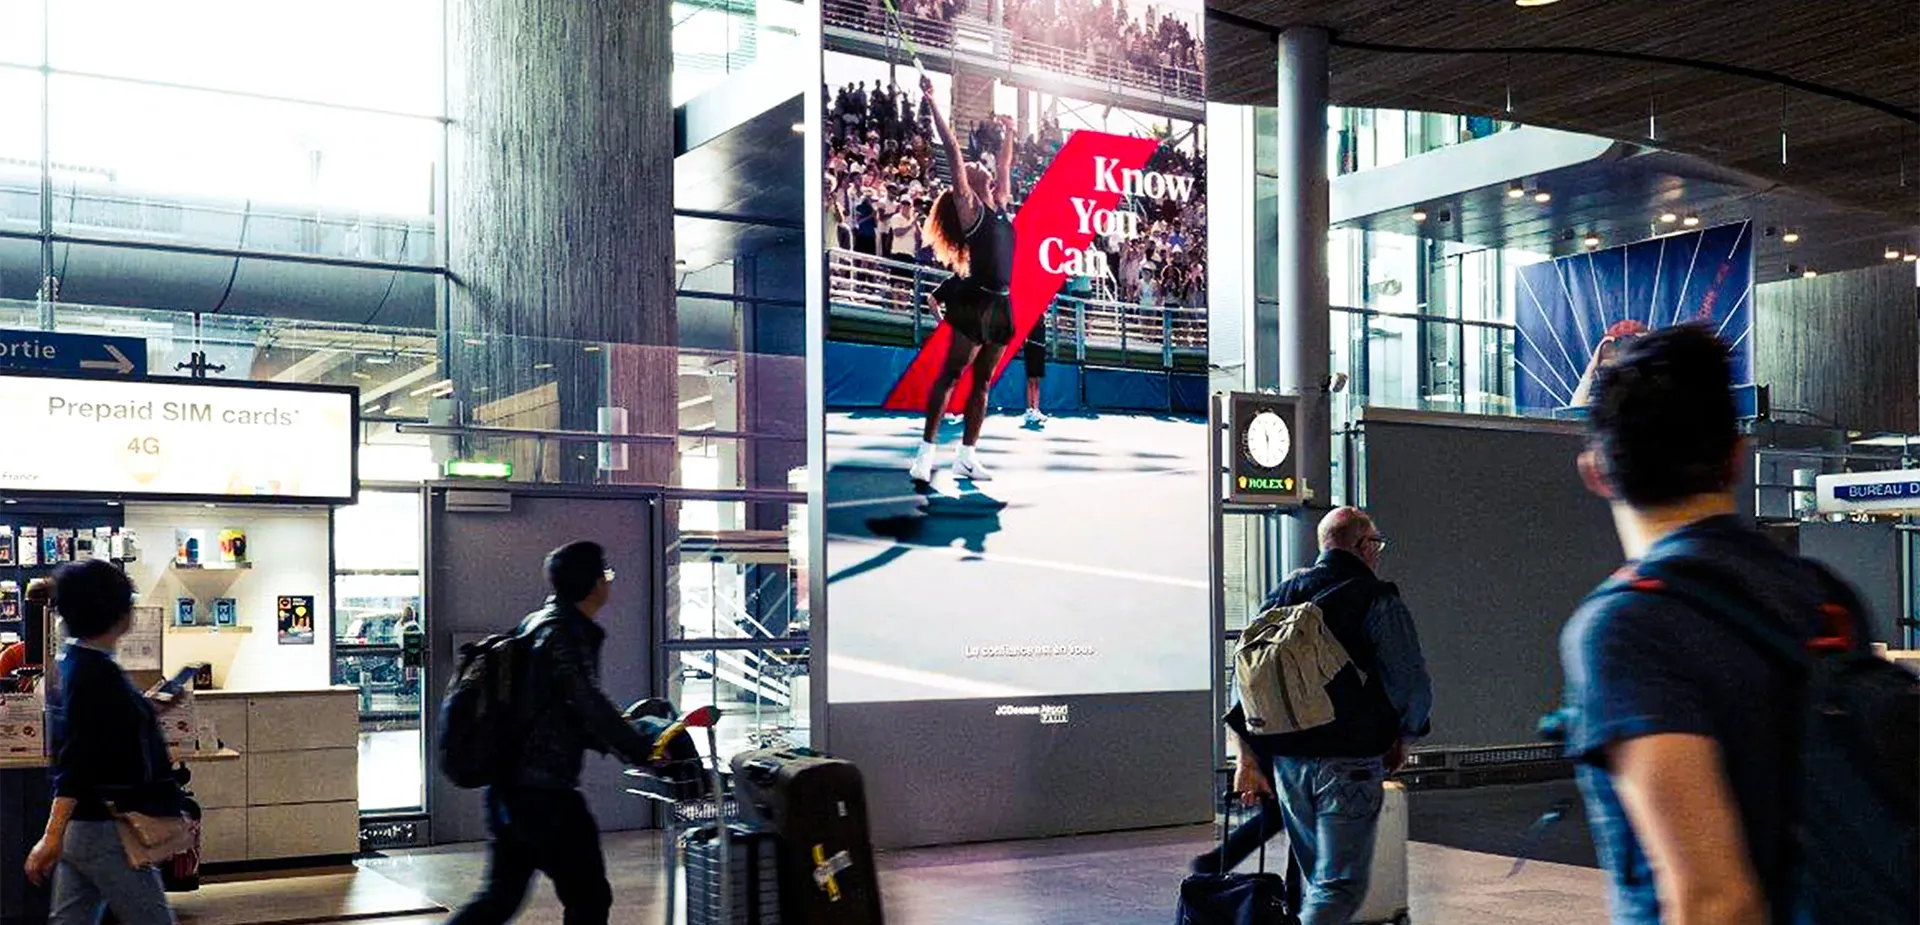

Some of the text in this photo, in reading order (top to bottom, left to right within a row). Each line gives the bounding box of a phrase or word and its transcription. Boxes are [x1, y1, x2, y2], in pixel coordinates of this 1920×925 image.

[1093, 156, 1195, 202] Know
[1070, 197, 1140, 240] You
[1039, 237, 1110, 279] Can
[48, 396, 153, 421] Prepaid
[163, 402, 212, 422] SIM
[127, 437, 160, 455] 4G
[1249, 478, 1284, 489] ROLEX
[1849, 484, 1902, 497] BUREAU
